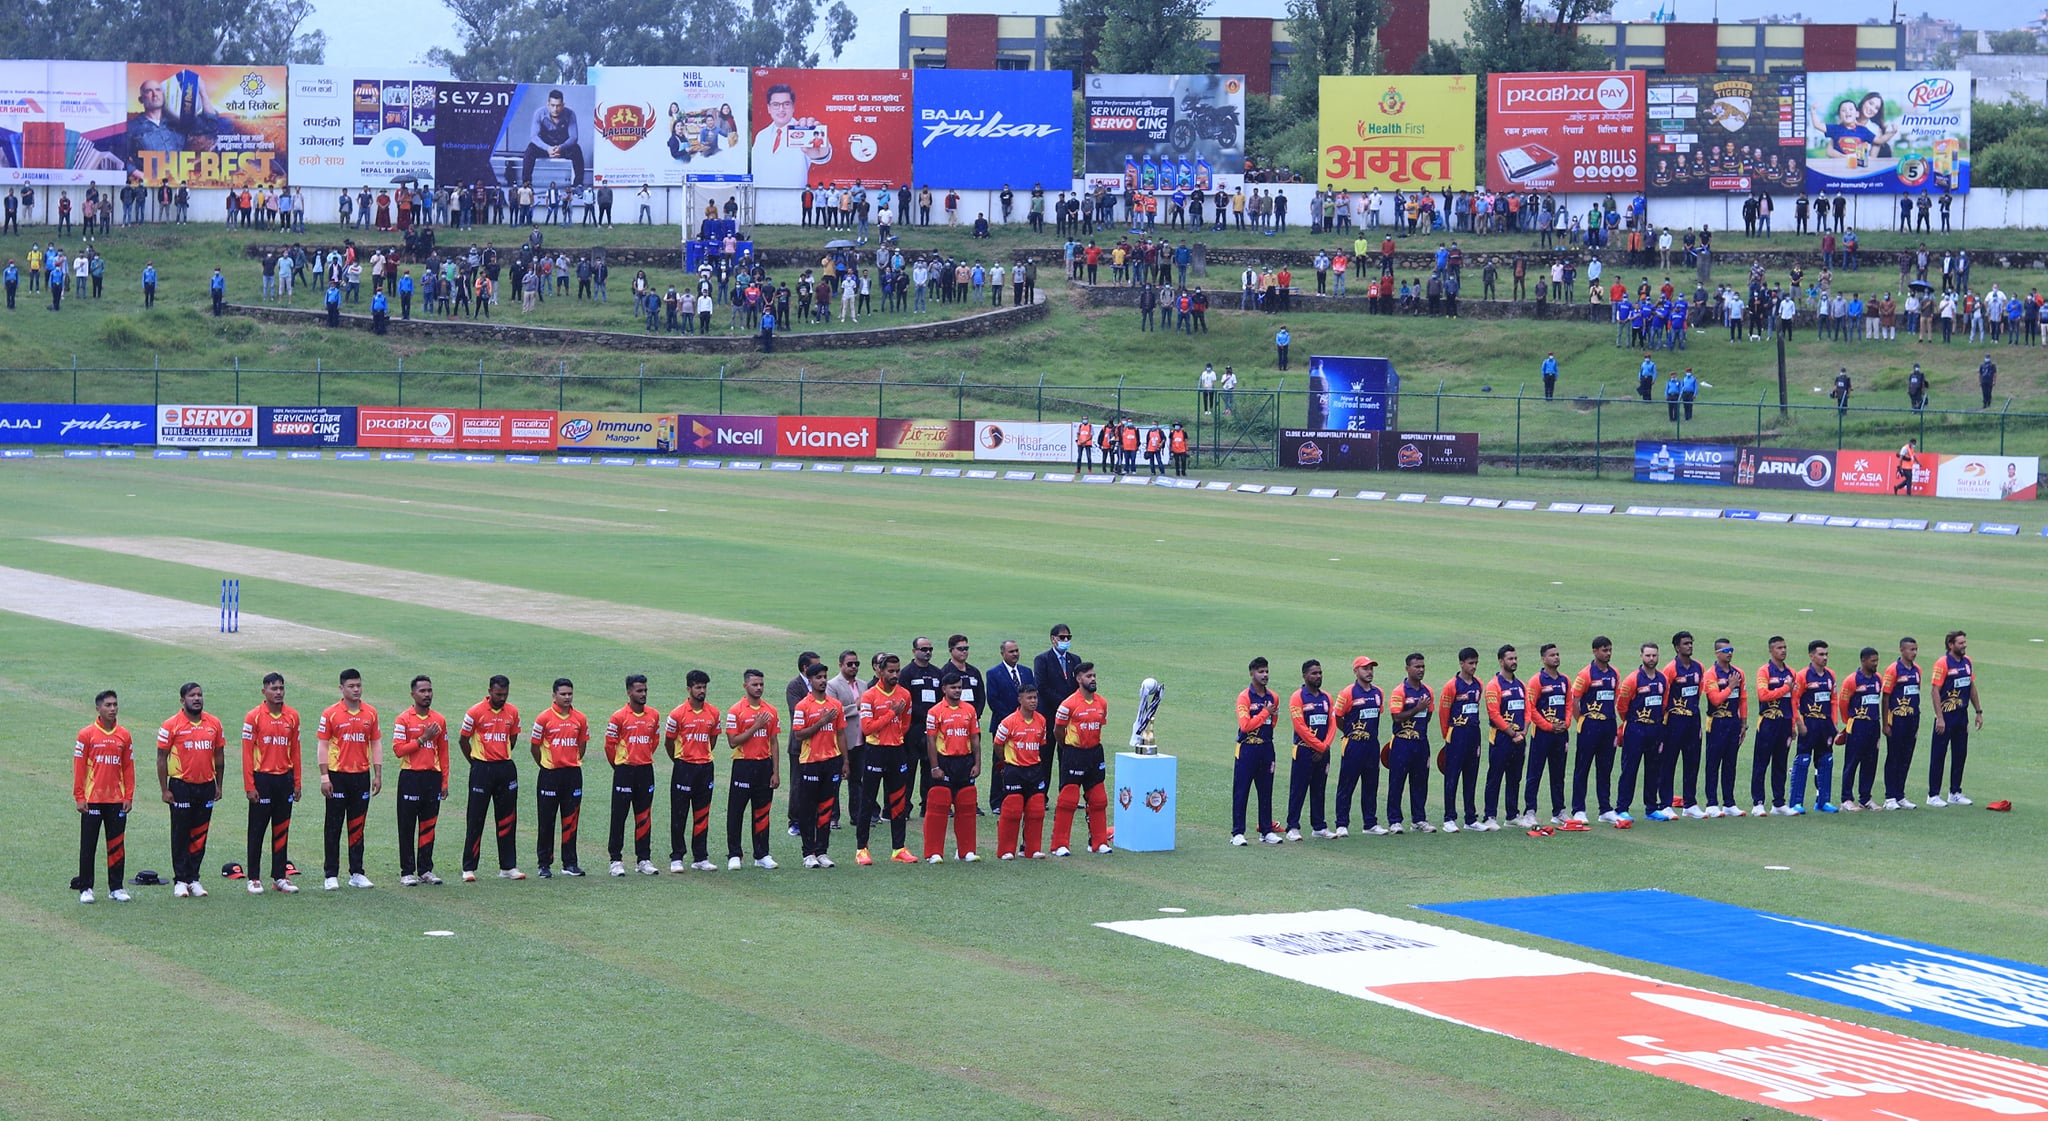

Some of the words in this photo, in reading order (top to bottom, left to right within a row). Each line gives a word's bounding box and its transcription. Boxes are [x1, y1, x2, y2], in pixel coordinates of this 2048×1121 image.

[682, 71, 704, 80] NIBL
[1600, 89, 1624, 98] PAY
[1715, 89, 1751, 98] TIGERS
[1913, 79, 1950, 107] Real
[921, 109, 985, 120] BAJAJ
[1091, 106, 1143, 116] SERVICING
[1092, 117, 1133, 129] SERVO
[1135, 117, 1168, 130] CING
[1901, 114, 1959, 126] Immuno
[602, 126, 648, 138] LALITPUR
[922, 110, 1063, 148] pulsar
[1368, 123, 1402, 134] Health
[1405, 123, 1425, 134] First
[1574, 150, 1597, 164] PAY
[1600, 149, 1637, 164] BILLS
[138, 150, 196, 186] THE
[200, 150, 275, 187] BEST
[1325, 145, 1456, 183] अमृत
[1908, 167, 1918, 178] 5
[1333, 401, 1380, 410] Refresment
[183, 410, 247, 426] SERVO
[272, 414, 319, 423] SERVICING
[60, 412, 147, 436] pulsar
[274, 424, 310, 433] SERVO
[311, 423, 340, 434] CING
[596, 420, 653, 433] Immuno
[163, 428, 209, 436] WORLD-CLASS
[210, 428, 250, 436] LUBRICANTS
[564, 422, 590, 440] Real
[717, 427, 763, 445] Ncell
[786, 425, 869, 448] vianet
[1285, 430, 1301, 438] CLOSE
[1316, 431, 1348, 439] HOSPITALITY
[605, 433, 640, 443] Mango+
[1004, 434, 1043, 444] Shikhar
[1017, 437, 1067, 451] Insurance
[1685, 450, 1722, 463] MATO
[1757, 461, 1808, 476] ARNA
[1810, 460, 1823, 480] 8
[1841, 472, 1859, 481] NIC
[1860, 473, 1883, 482] ASIA
[1957, 478, 1976, 487] Surya
[1977, 478, 1991, 486] Life
[349, 733, 365, 742] NIBL
[693, 733, 710, 742] NIBL
[954, 727, 968, 737] NIBL
[193, 740, 213, 750] NIBL
[560, 737, 578, 747] NIBL
[635, 735, 650, 745] NIBL
[1025, 742, 1040, 751] NIBL
[104, 754, 121, 765] NIBL
